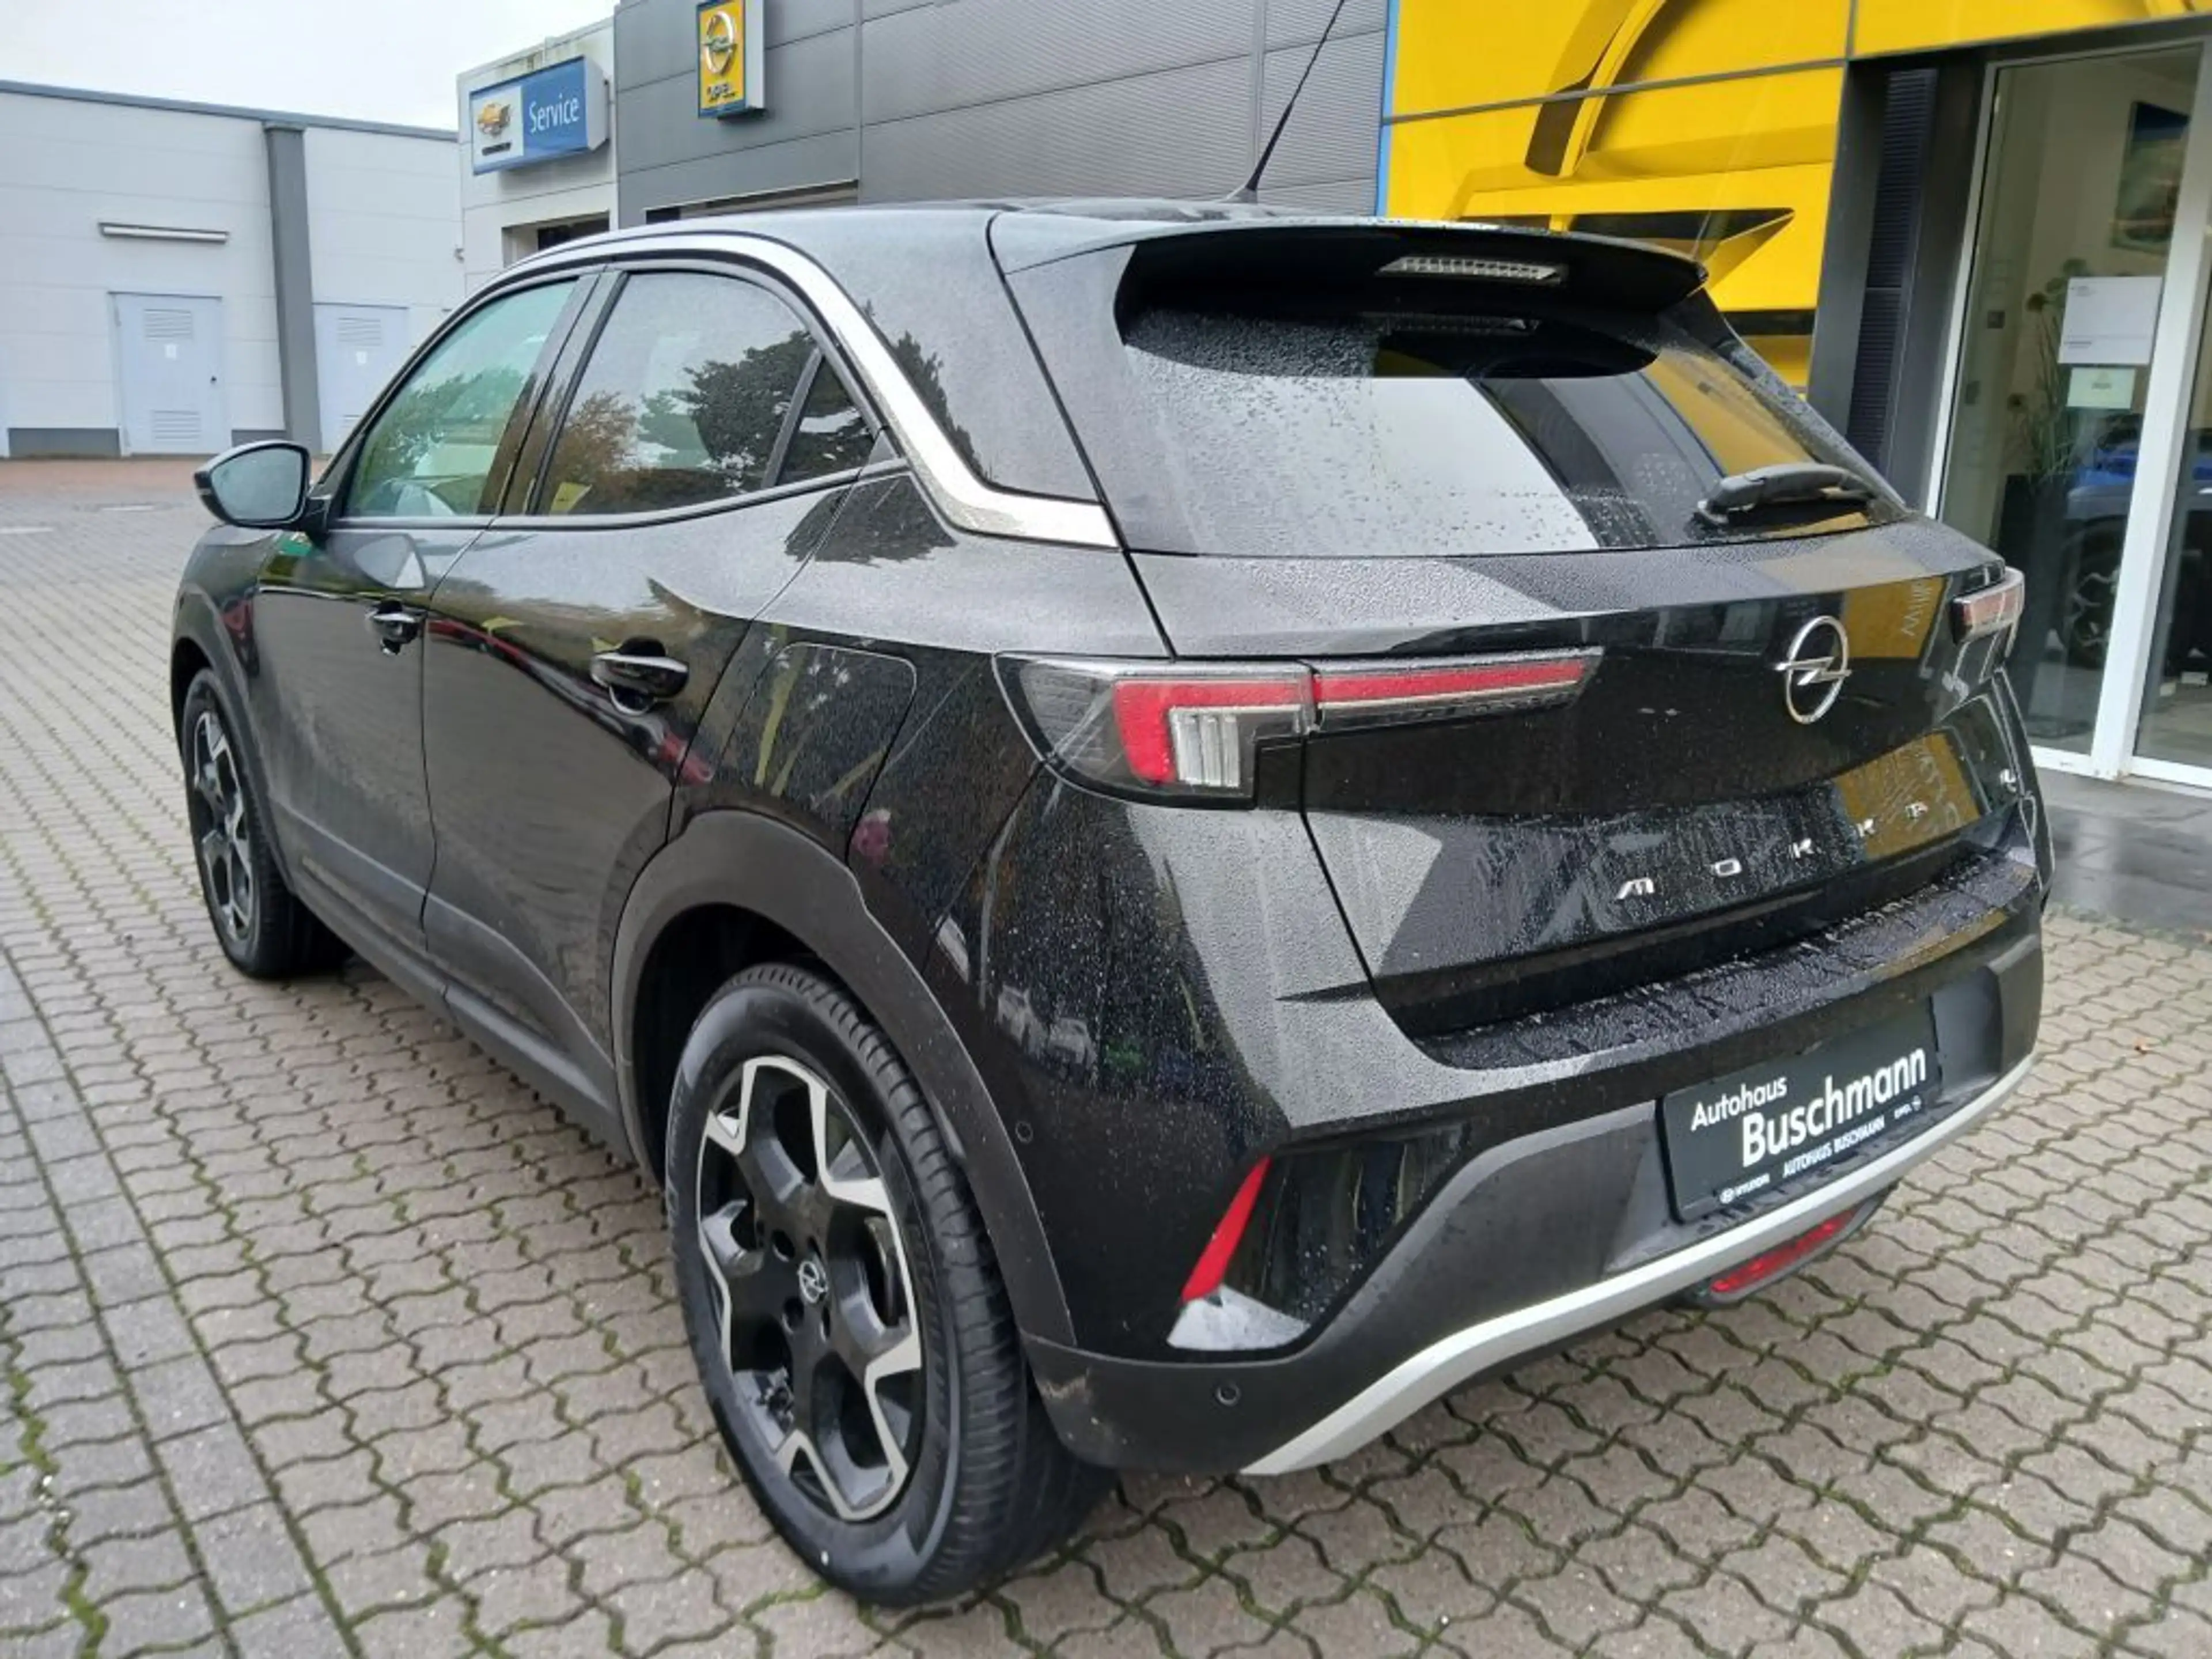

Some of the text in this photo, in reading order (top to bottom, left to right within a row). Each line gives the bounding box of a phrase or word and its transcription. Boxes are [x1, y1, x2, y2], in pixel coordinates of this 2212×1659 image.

[529, 92, 580, 134] Service
[1690, 1076, 1788, 1131] Autohaus
[1741, 1047, 1926, 1168] Buschmann
[1782, 1115, 1885, 1179] AUTOHAUS BUSCHMANN
